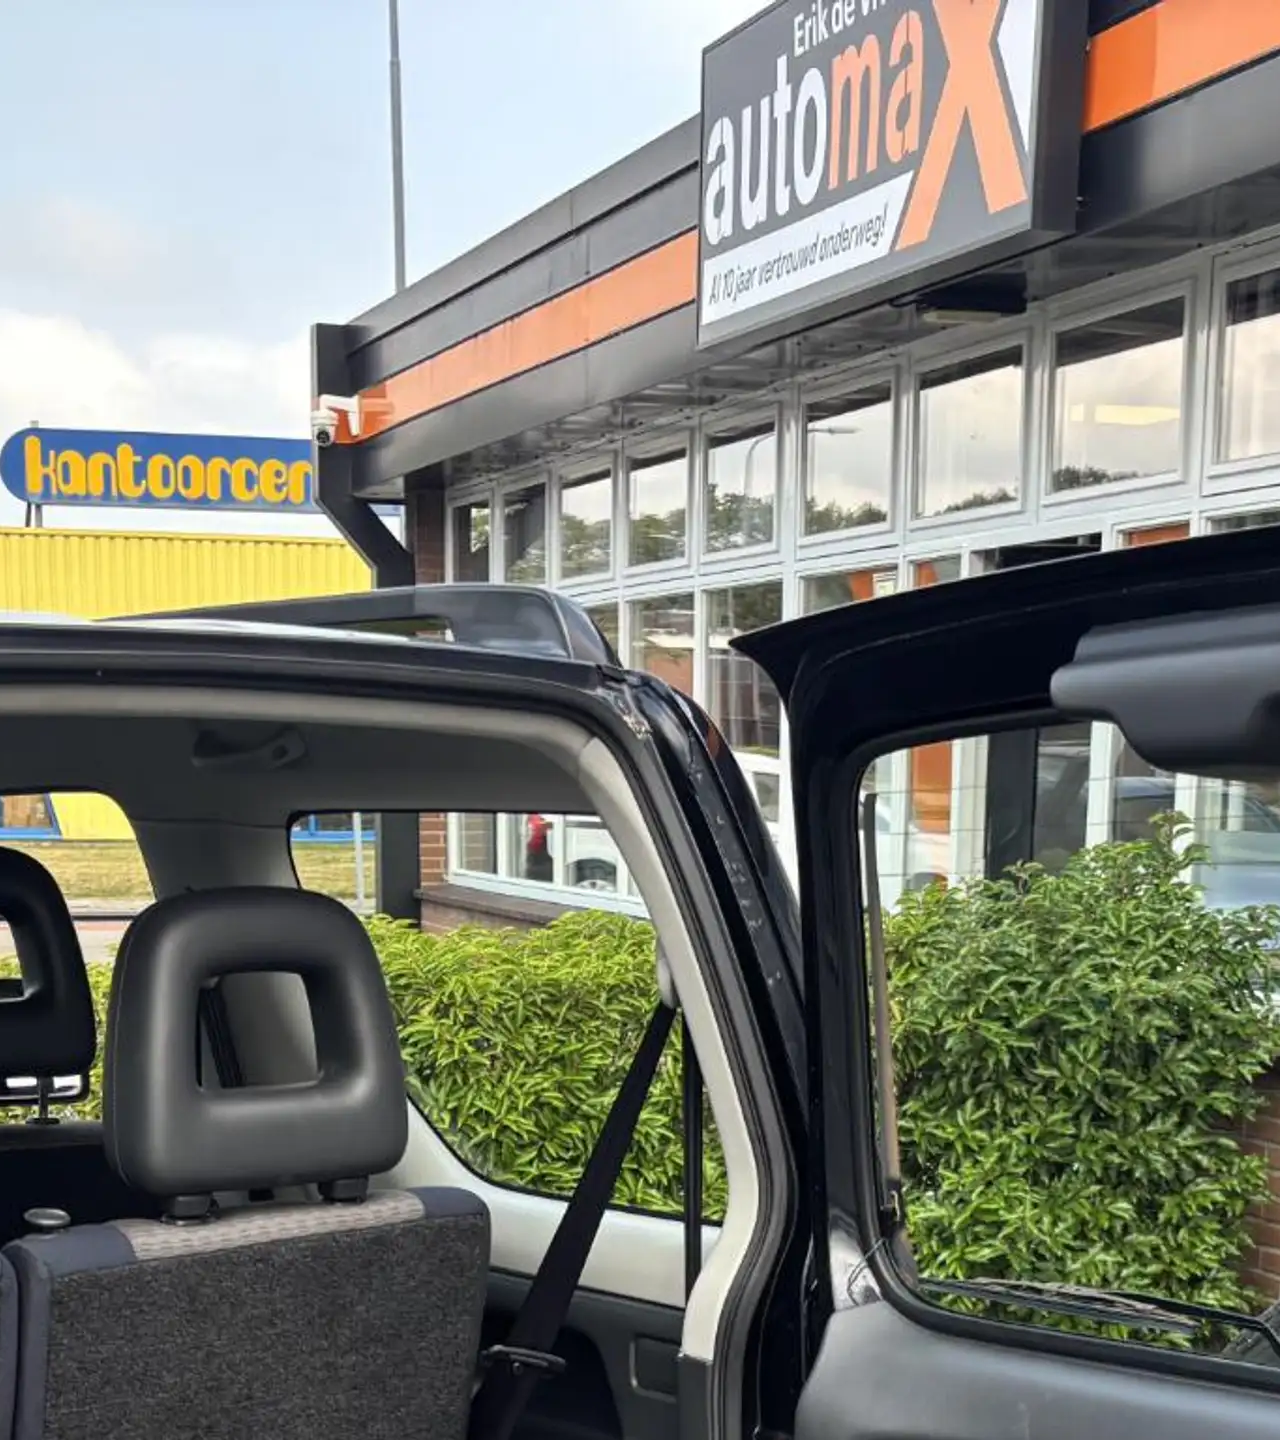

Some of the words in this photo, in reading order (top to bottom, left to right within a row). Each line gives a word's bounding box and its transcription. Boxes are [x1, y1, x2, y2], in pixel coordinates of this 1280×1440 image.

[794, 0, 829, 57] Erik
[733, 263, 758, 302] jaar
[758, 232, 820, 287] vertrouwd
[819, 200, 889, 262] onderweg!
